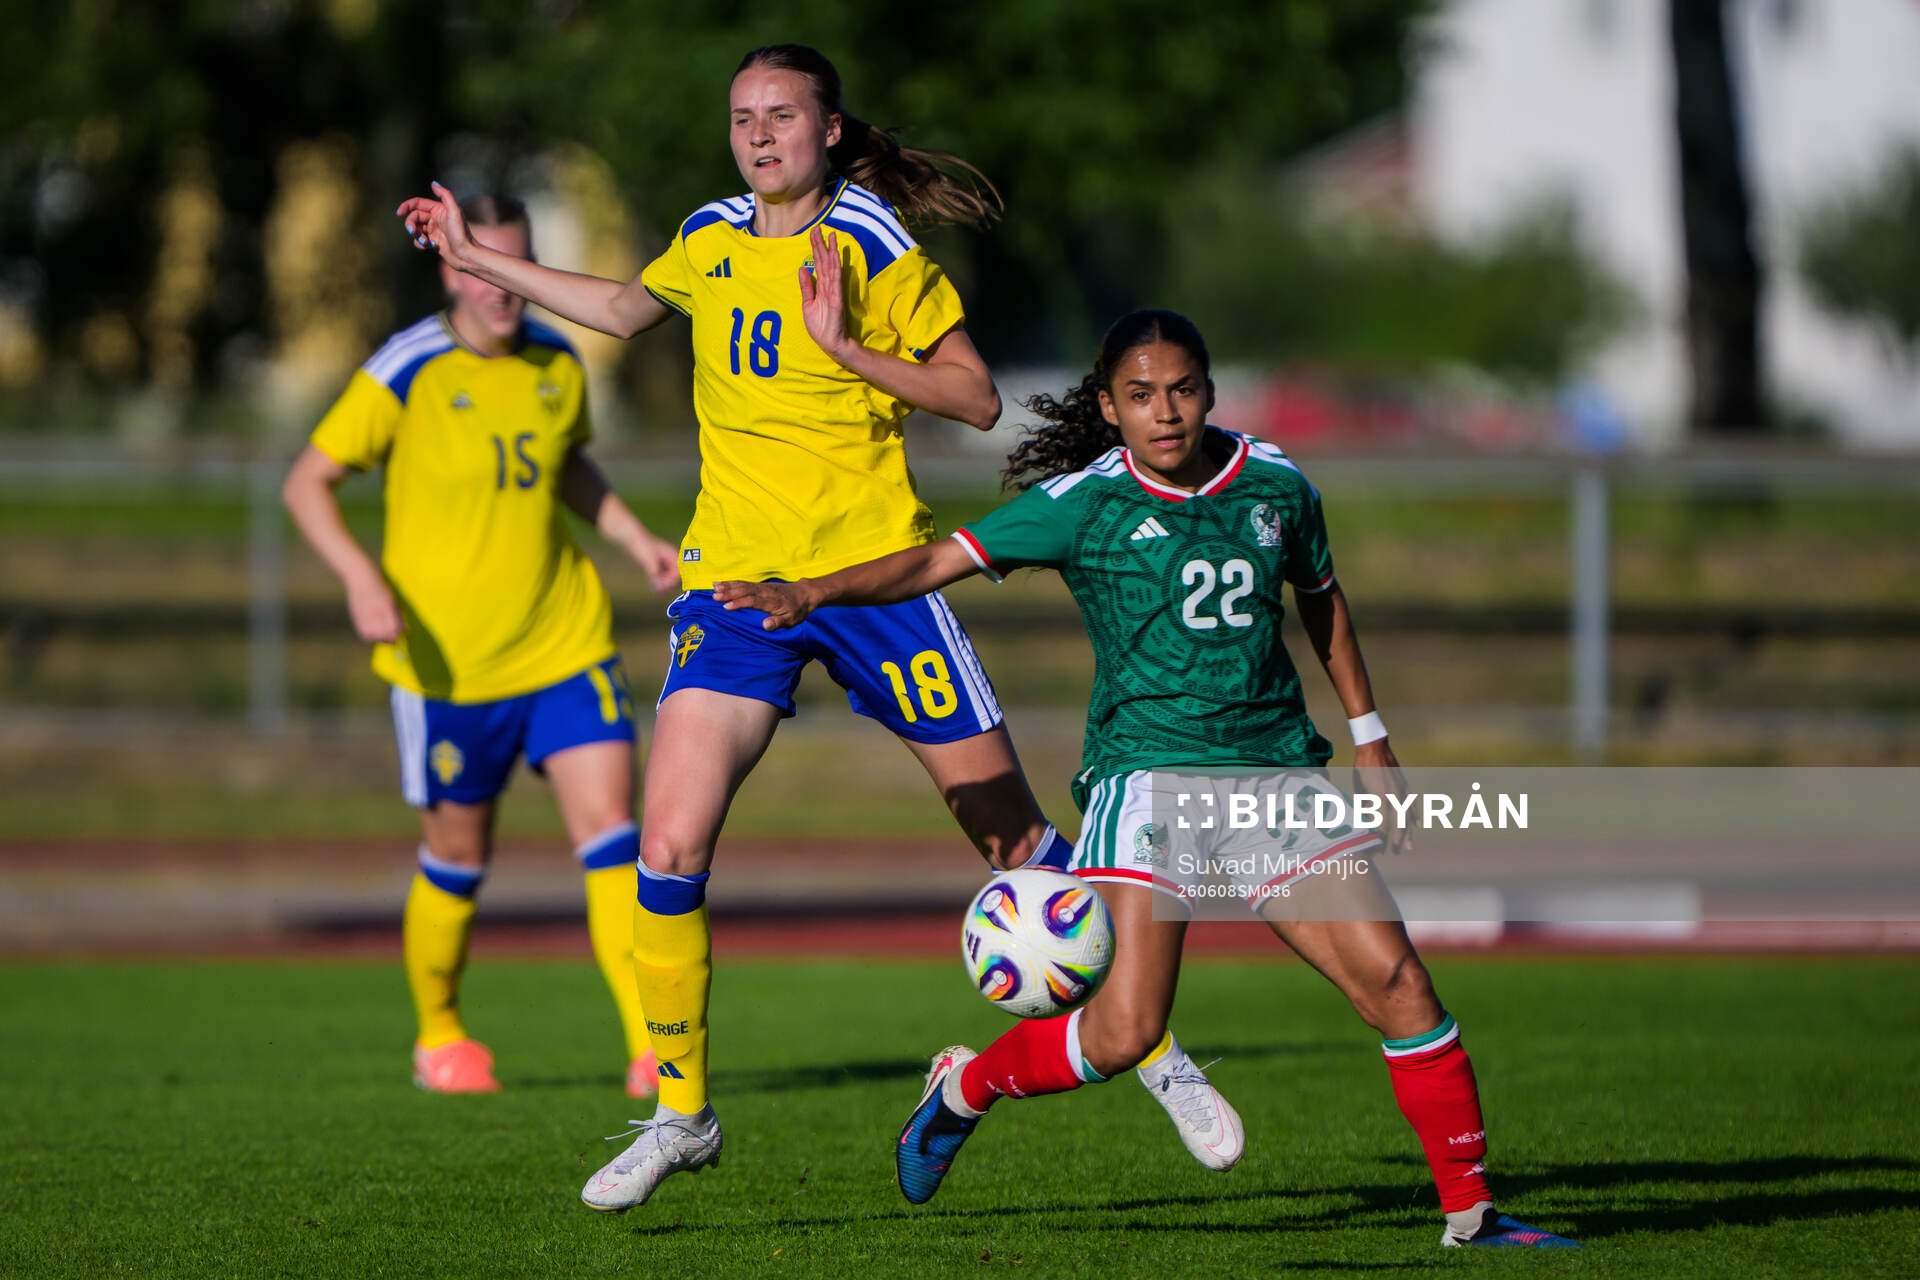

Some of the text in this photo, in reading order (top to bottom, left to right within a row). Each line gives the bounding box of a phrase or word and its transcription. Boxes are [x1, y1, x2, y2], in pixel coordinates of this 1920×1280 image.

[729, 306, 783, 379] 18
[492, 432, 541, 491] 15
[1181, 558, 1255, 630] 22
[880, 649, 959, 723] 18
